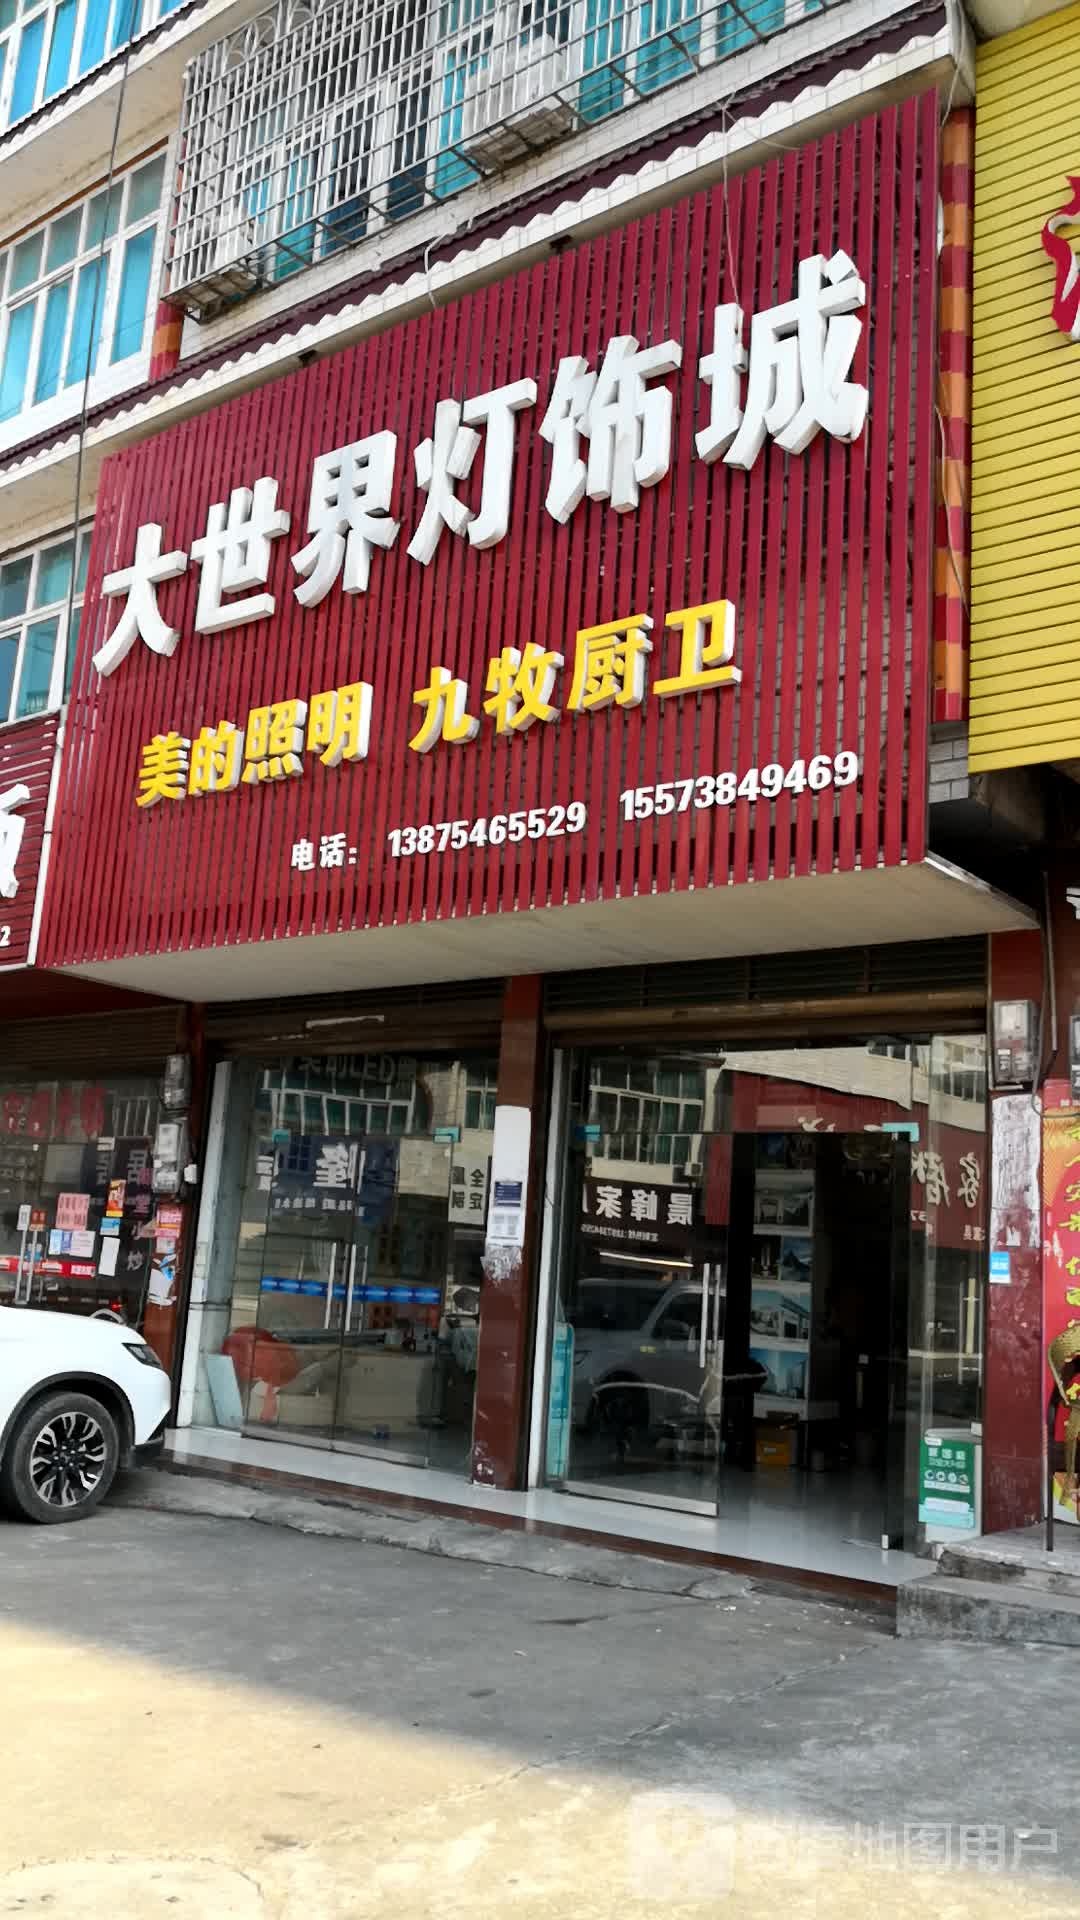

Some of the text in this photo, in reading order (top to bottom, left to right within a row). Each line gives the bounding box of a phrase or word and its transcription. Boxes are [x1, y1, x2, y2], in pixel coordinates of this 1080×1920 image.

[92, 249, 867, 677] 大世界灯饰城
[137, 598, 742, 808] 美的照明 九牧厨卫
[387, 801, 587, 857] 13875465529
[619, 751, 859, 821] 15573849469
